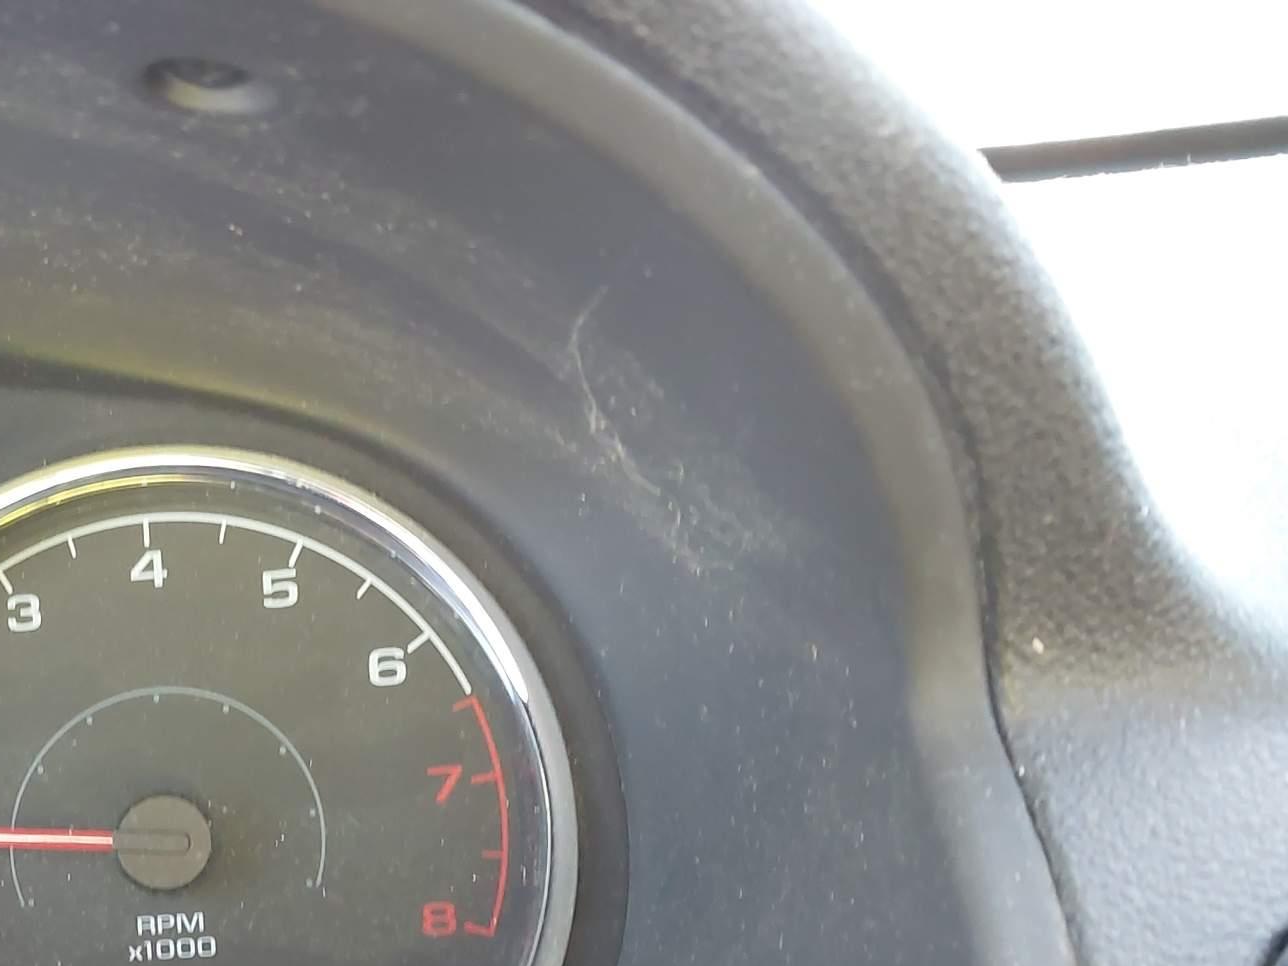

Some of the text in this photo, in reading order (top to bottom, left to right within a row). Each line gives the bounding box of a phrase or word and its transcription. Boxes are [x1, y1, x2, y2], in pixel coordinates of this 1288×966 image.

[131, 551, 168, 587] 4
[262, 570, 298, 608] 5
[7, 594, 41, 631] 3
[367, 648, 407, 686] 6
[427, 767, 463, 802] 7
[136, 913, 205, 936] RPM
[421, 903, 456, 937] 8
[128, 938, 217, 961] x1000
